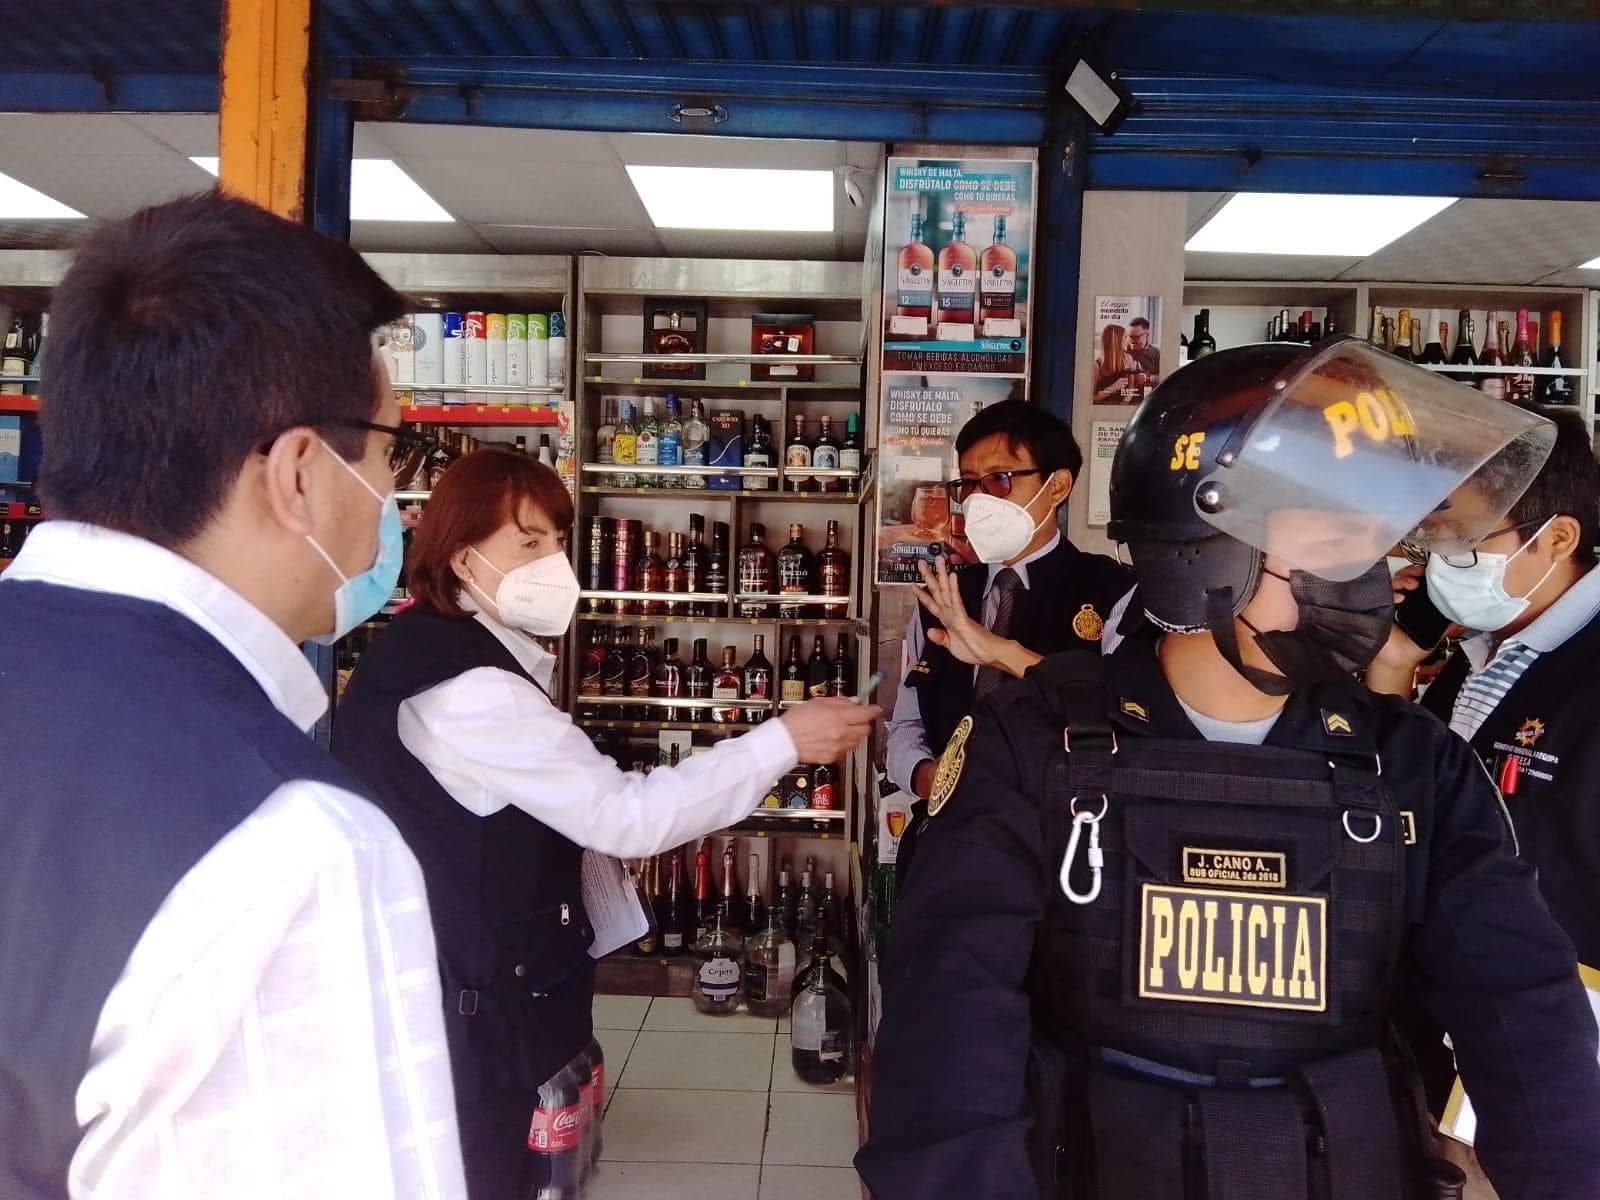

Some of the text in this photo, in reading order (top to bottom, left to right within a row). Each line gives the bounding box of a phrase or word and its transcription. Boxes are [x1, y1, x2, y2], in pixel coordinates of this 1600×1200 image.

[900, 168, 926, 177] WHISKY
[928, 168, 937, 177] DE
[900, 177, 1016, 191] DISFRÚTALO COMO SE DEBE
[954, 193, 974, 201] COMO
[901, 295, 911, 305] 12
[943, 298, 951, 308] 15
[898, 351, 923, 361] TOMAR
[926, 352, 958, 362] BEBIDAS
[890, 390, 921, 400] WHISKY
[922, 391, 933, 400] DE
[890, 413, 953, 424] COMO SE DEBE
[1170, 432, 1205, 471] SE
[892, 543, 928, 554] SINGLETON
[889, 563, 915, 571] TOMAR
[1197, 855, 1271, 872] J. CANO A.
[1189, 867, 1207, 878] SUB
[1207, 868, 1241, 880] OFICIAL
[1150, 896, 1316, 1000] POLICIA
